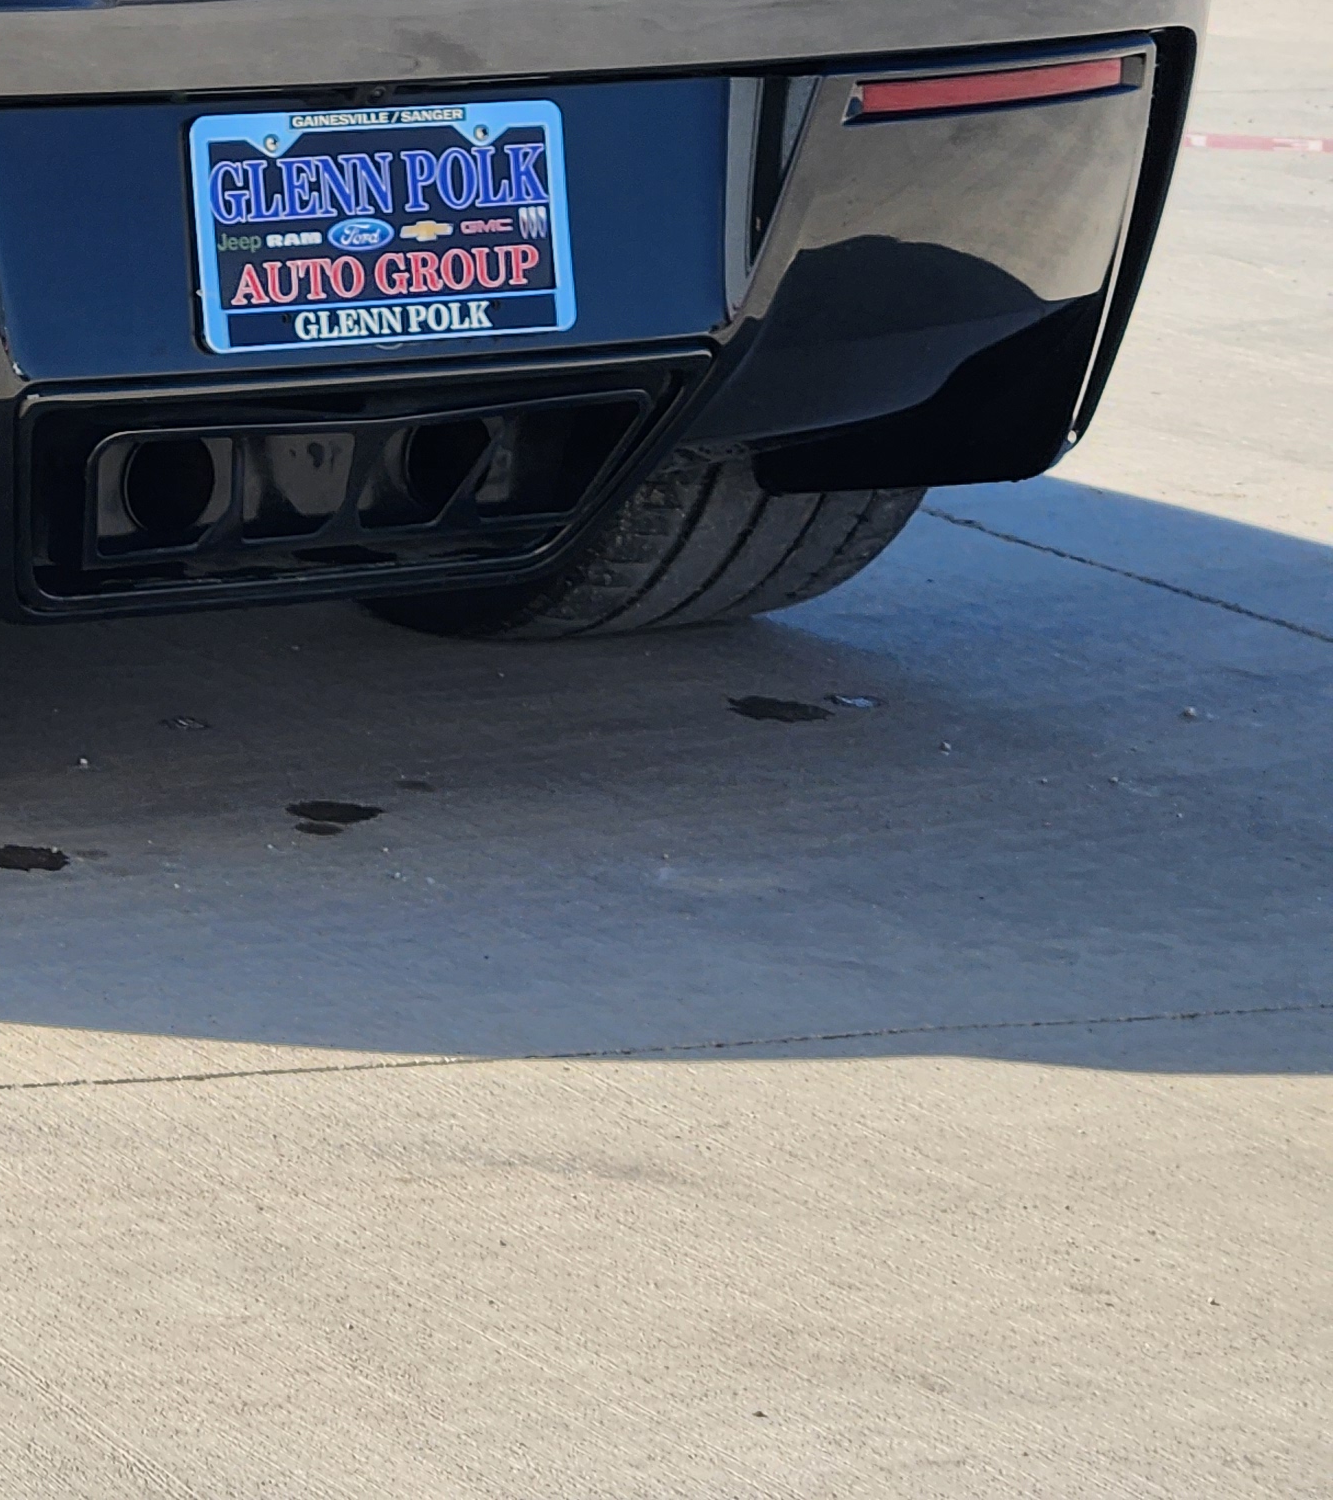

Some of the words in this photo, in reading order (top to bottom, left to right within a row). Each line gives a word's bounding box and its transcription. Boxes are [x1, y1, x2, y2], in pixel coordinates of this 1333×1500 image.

[291, 112, 389, 128] GAINESVILLE
[400, 109, 464, 123] SANGER
[209, 152, 393, 225] GLENN
[400, 143, 550, 213] POLK
[217, 233, 263, 254] Jeep
[266, 231, 323, 248] RAM
[339, 223, 382, 246] Ford
[460, 218, 514, 235] GMC
[230, 257, 365, 306] AUTO
[374, 244, 539, 296] GROUP
[294, 306, 403, 341] GLENN
[406, 300, 493, 333] POLK
